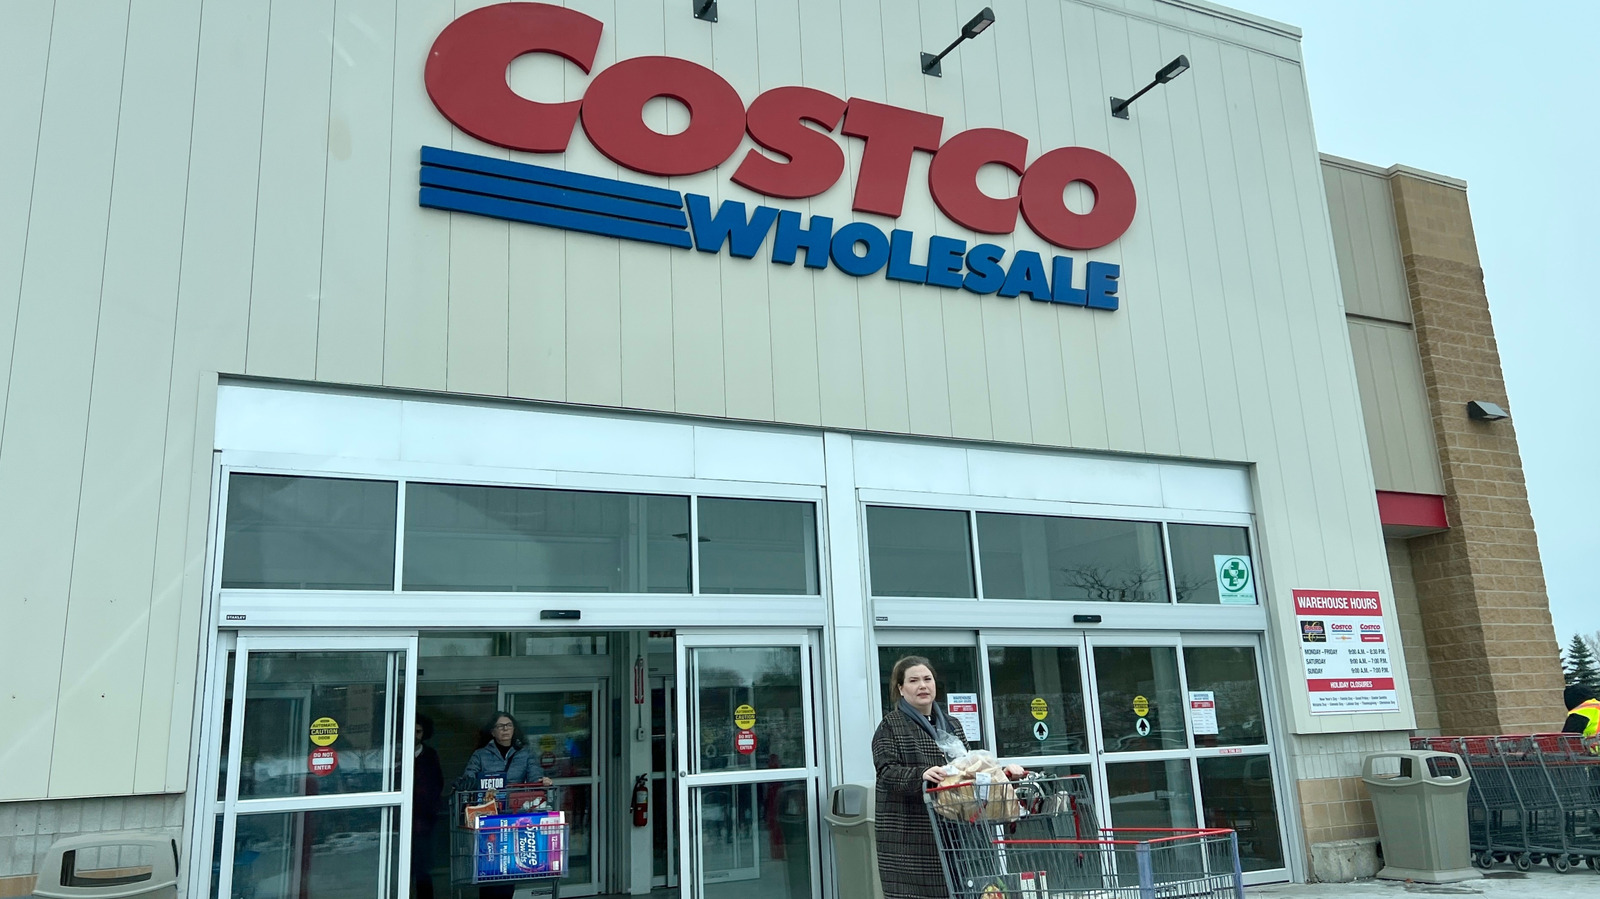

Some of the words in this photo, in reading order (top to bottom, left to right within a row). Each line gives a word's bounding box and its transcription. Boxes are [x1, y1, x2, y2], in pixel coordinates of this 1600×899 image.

[424, 2, 1137, 250] COSTCO
[685, 193, 1121, 311] WHOLESALE
[1297, 596, 1349, 609] WAREHOUSE
[1350, 598, 1378, 610] HOURS
[480, 778, 503, 789] VECTOR
[524, 823, 538, 866] Sponge
